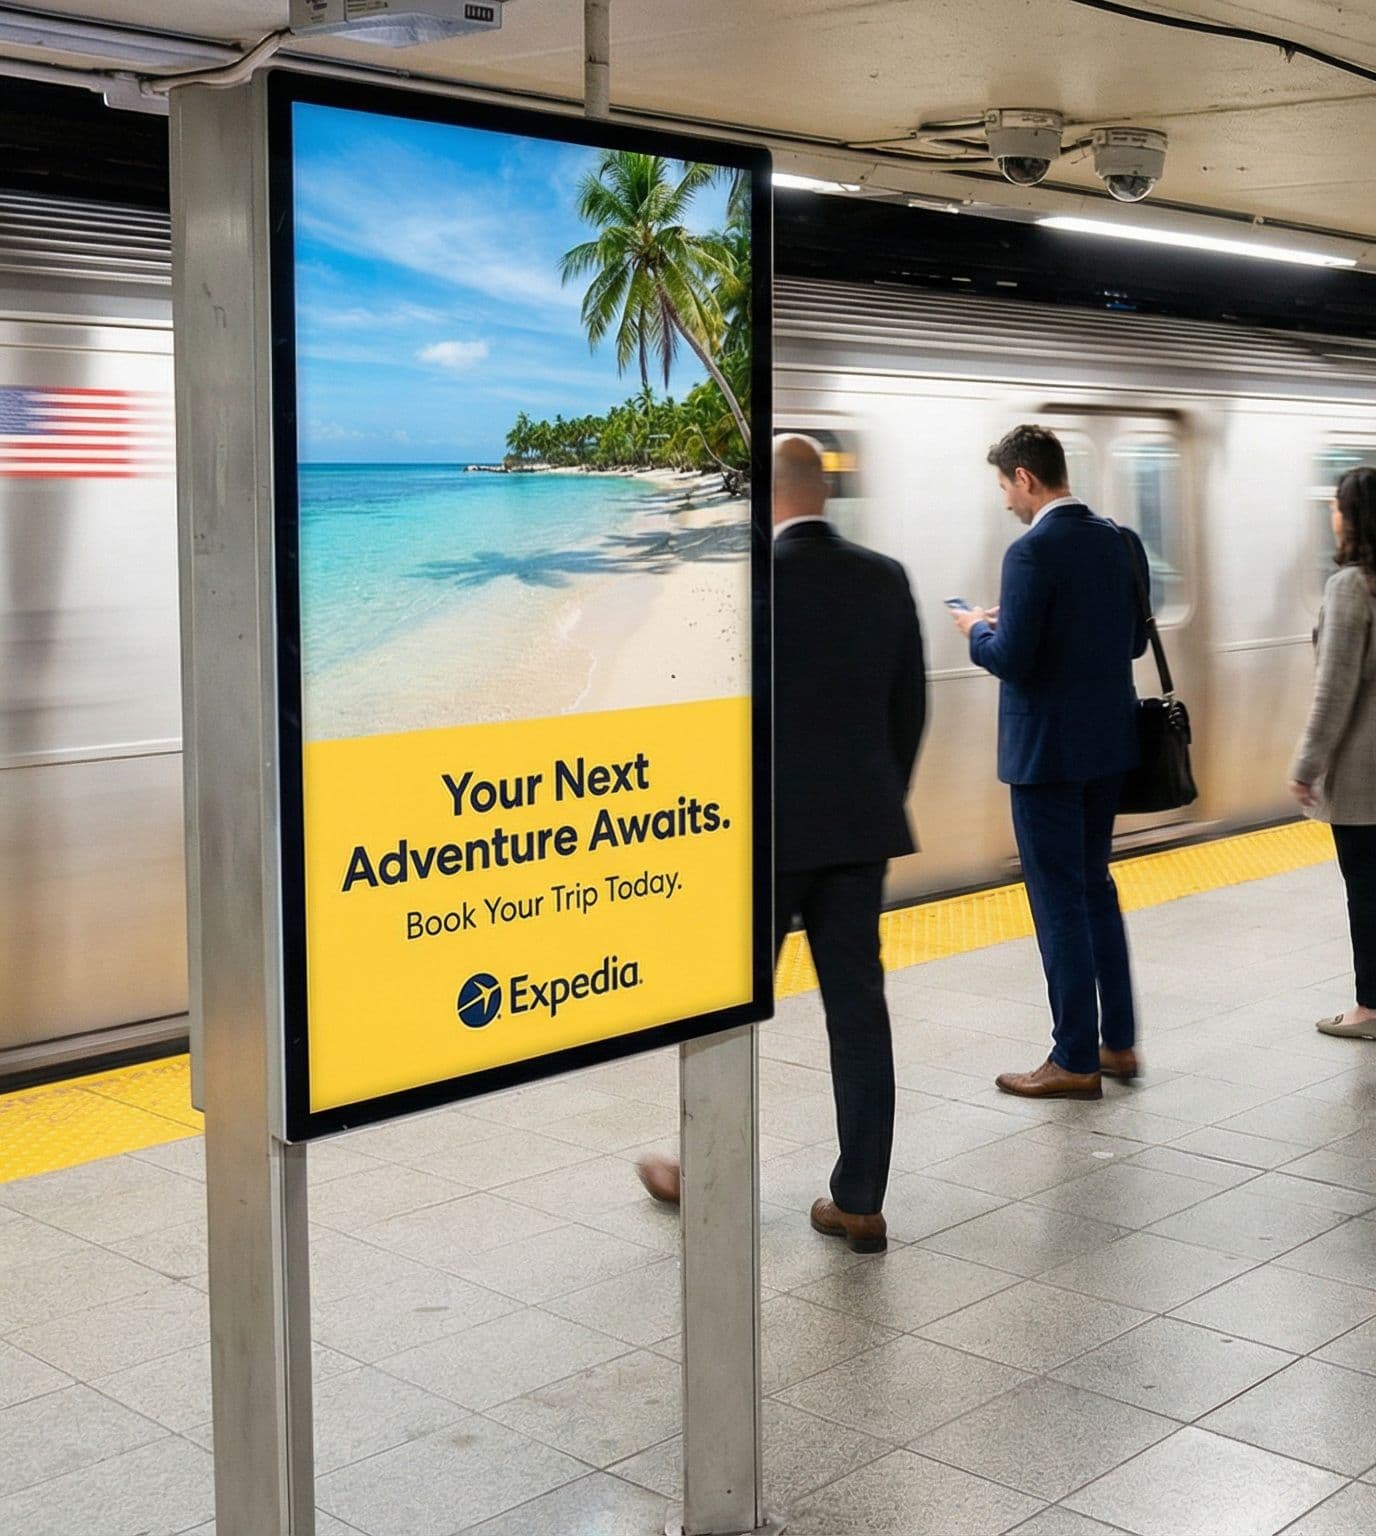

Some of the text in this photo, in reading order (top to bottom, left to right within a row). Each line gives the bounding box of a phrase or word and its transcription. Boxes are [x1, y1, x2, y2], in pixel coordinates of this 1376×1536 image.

[442, 753, 650, 817] Your Next
[342, 796, 731, 893] Adventure Awaits.
[407, 870, 682, 940] Book Your Trip Today.
